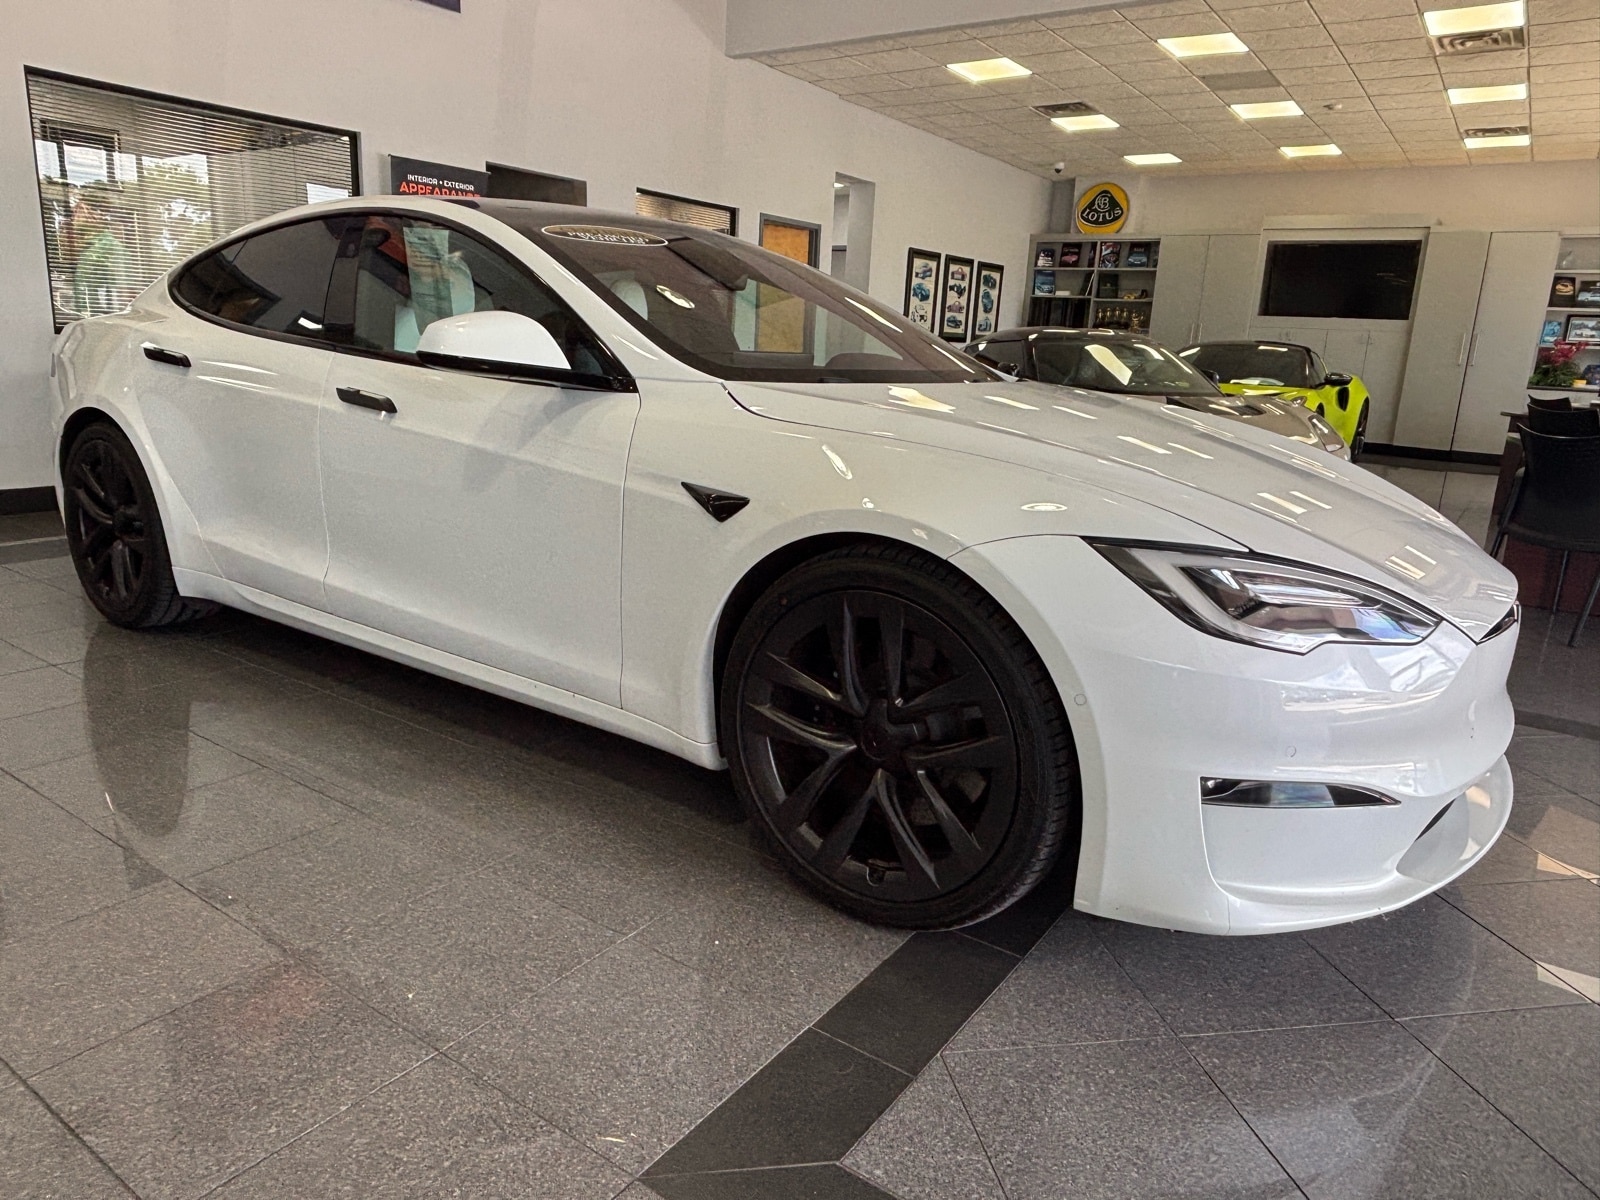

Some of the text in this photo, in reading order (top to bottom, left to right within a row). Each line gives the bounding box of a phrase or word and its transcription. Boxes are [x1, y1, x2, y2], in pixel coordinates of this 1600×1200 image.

[407, 173, 475, 191] INTERIOR EXTERIOR
[1082, 207, 1122, 222] LOTUS
